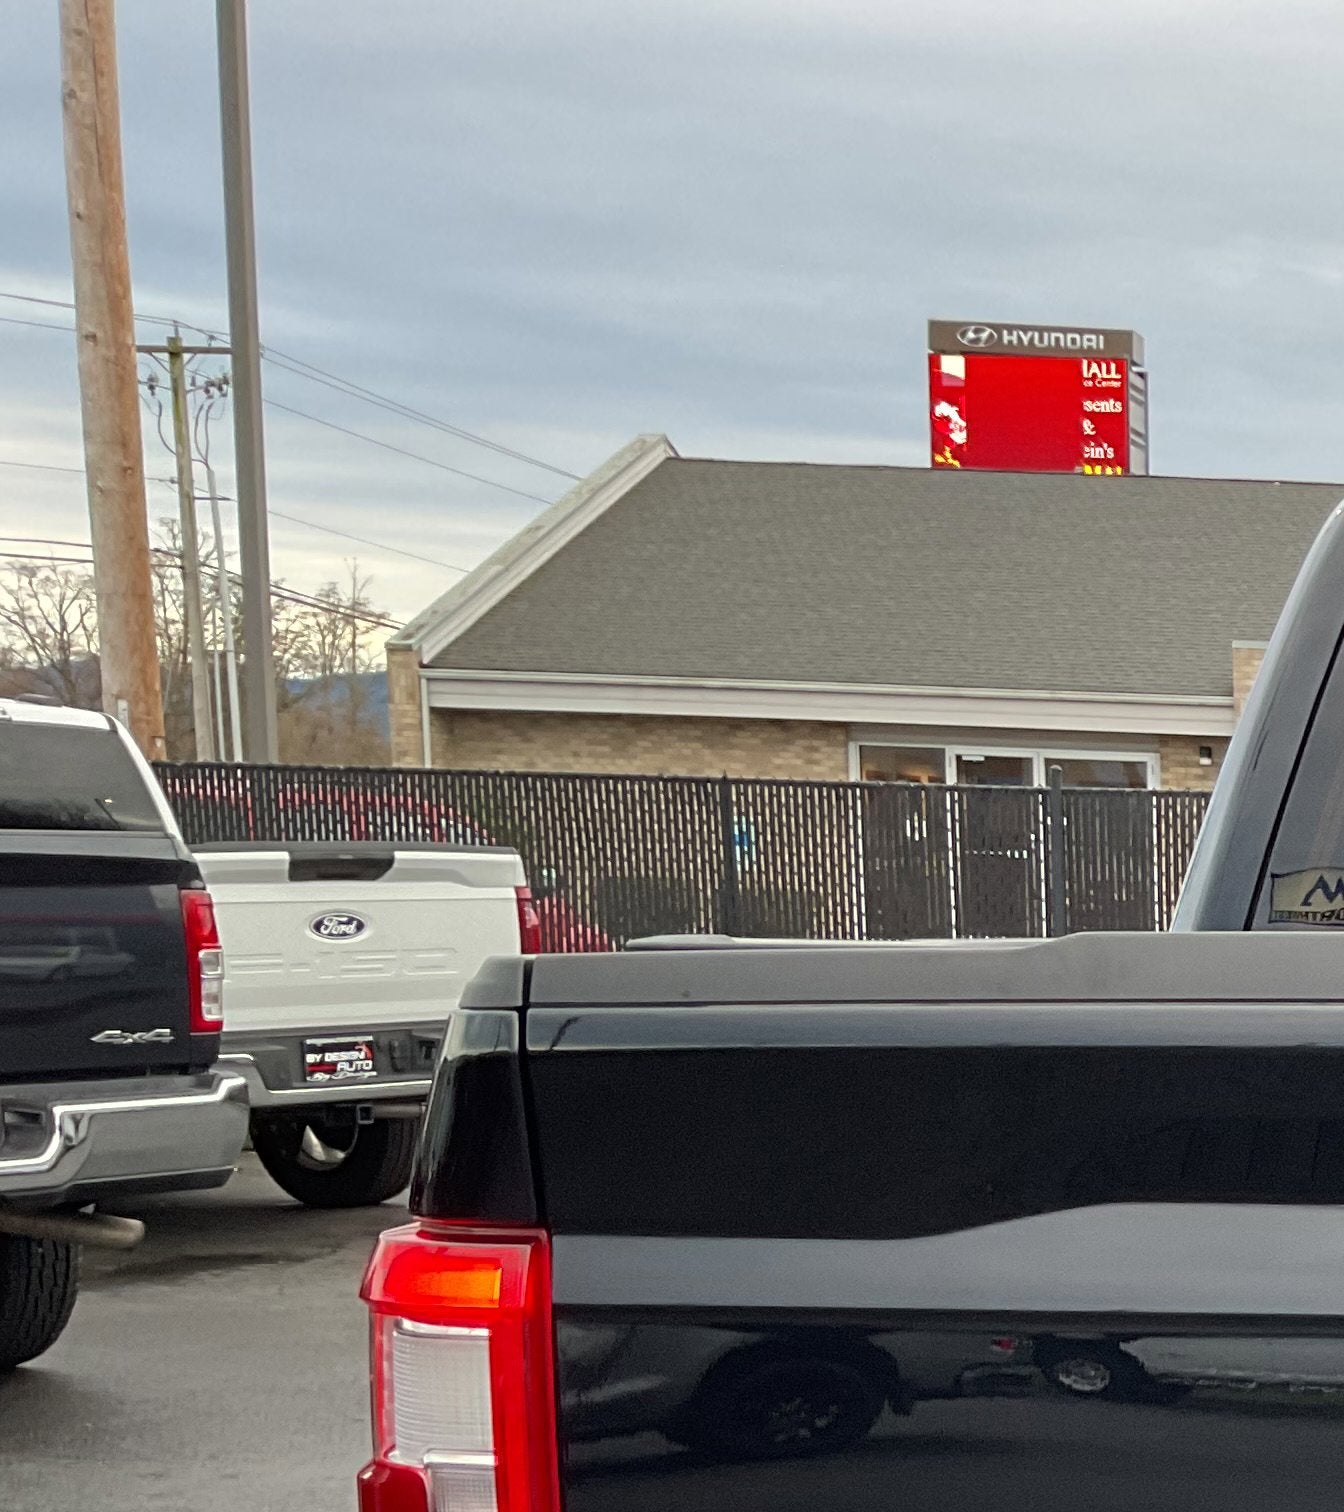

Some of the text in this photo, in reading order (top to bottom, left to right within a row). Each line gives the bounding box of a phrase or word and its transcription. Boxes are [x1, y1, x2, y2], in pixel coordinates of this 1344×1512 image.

[1002, 329, 1104, 350] HYUNDAI
[320, 916, 358, 934] Ford
[337, 1060, 373, 1071] AUTO
